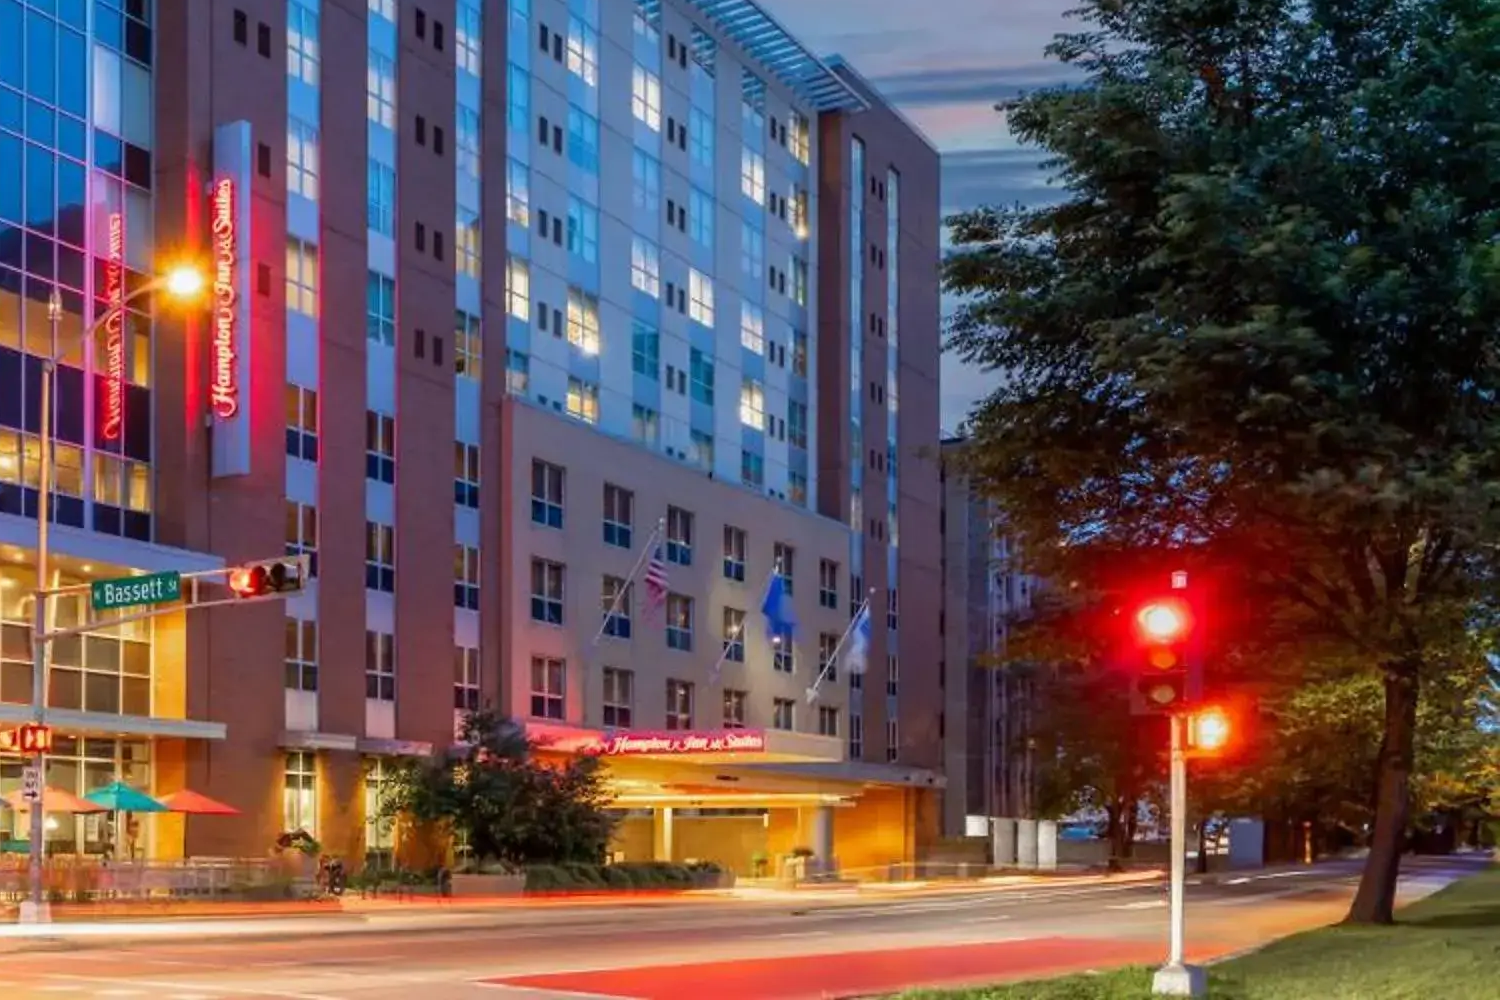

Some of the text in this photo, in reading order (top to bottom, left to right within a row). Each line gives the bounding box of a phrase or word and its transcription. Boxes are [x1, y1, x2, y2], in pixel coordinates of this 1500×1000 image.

[212, 179, 232, 238] Suites
[214, 252, 234, 306] Inn
[211, 309, 238, 417] Hampton
[104, 577, 163, 604] Bassett
[609, 736, 680, 755] Hampton
[678, 735, 709, 753] Inn
[722, 733, 762, 749] Suites
